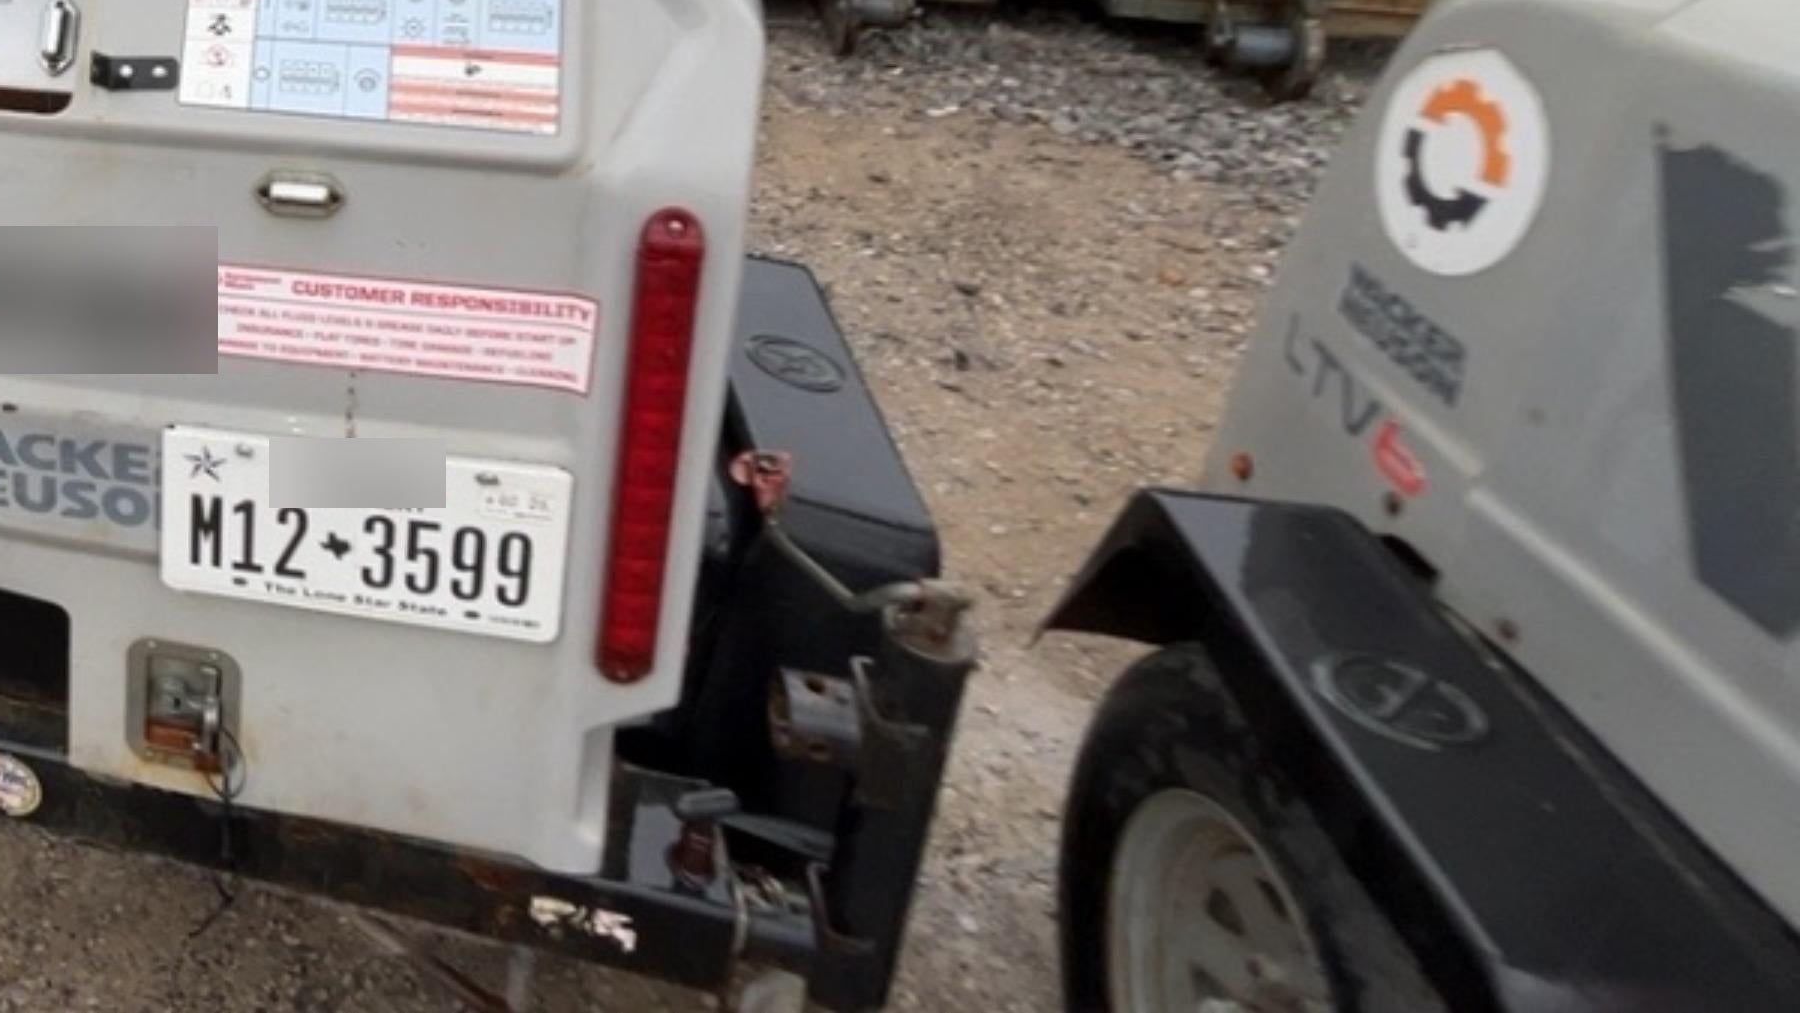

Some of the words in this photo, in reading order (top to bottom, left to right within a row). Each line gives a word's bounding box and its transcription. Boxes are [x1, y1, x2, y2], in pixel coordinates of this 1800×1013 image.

[291, 280, 406, 304] CUSTOMER
[410, 291, 590, 321] RESPONSIBILITY
[264, 581, 297, 596] The
[303, 587, 346, 604] Lone
[353, 594, 391, 609] Star
[399, 600, 449, 617] State
